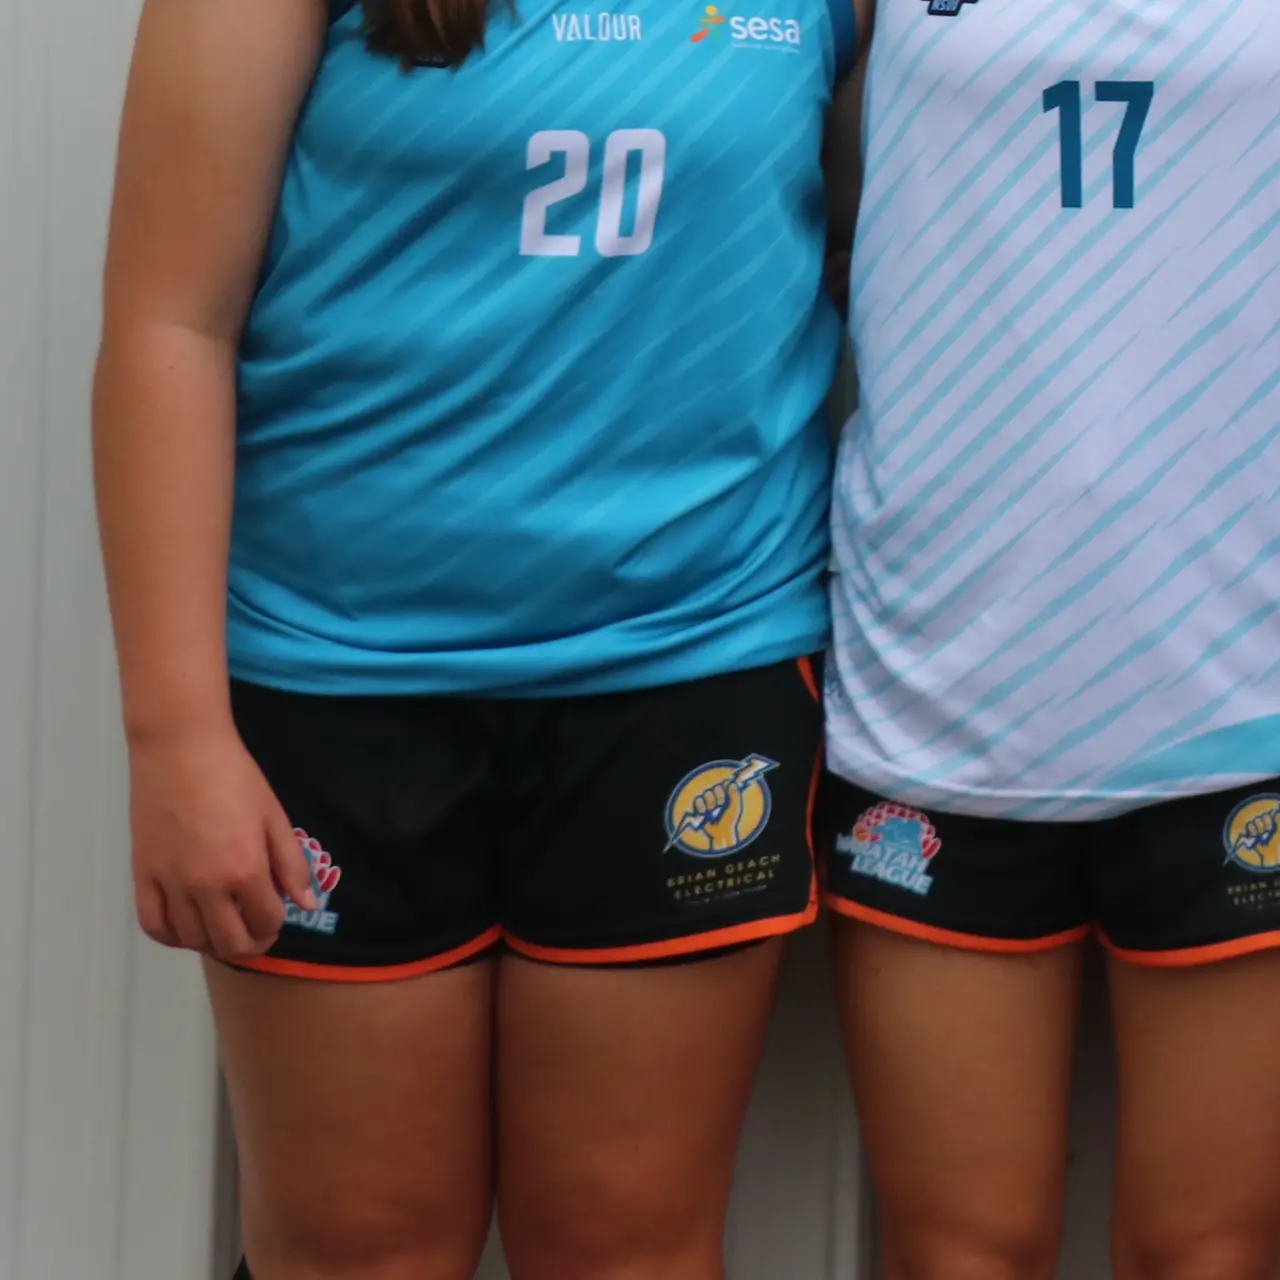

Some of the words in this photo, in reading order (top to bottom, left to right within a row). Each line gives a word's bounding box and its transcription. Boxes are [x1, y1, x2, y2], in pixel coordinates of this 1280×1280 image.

[552, 12, 642, 42] VALOUR
[730, 16, 800, 45] sesa
[1042, 80, 1154, 209] 17
[519, 128, 666, 257] 20
[667, 868, 717, 888] BRIAN
[674, 869, 775, 899] ELECTRICAL
[851, 854, 934, 896] LEAGUE
